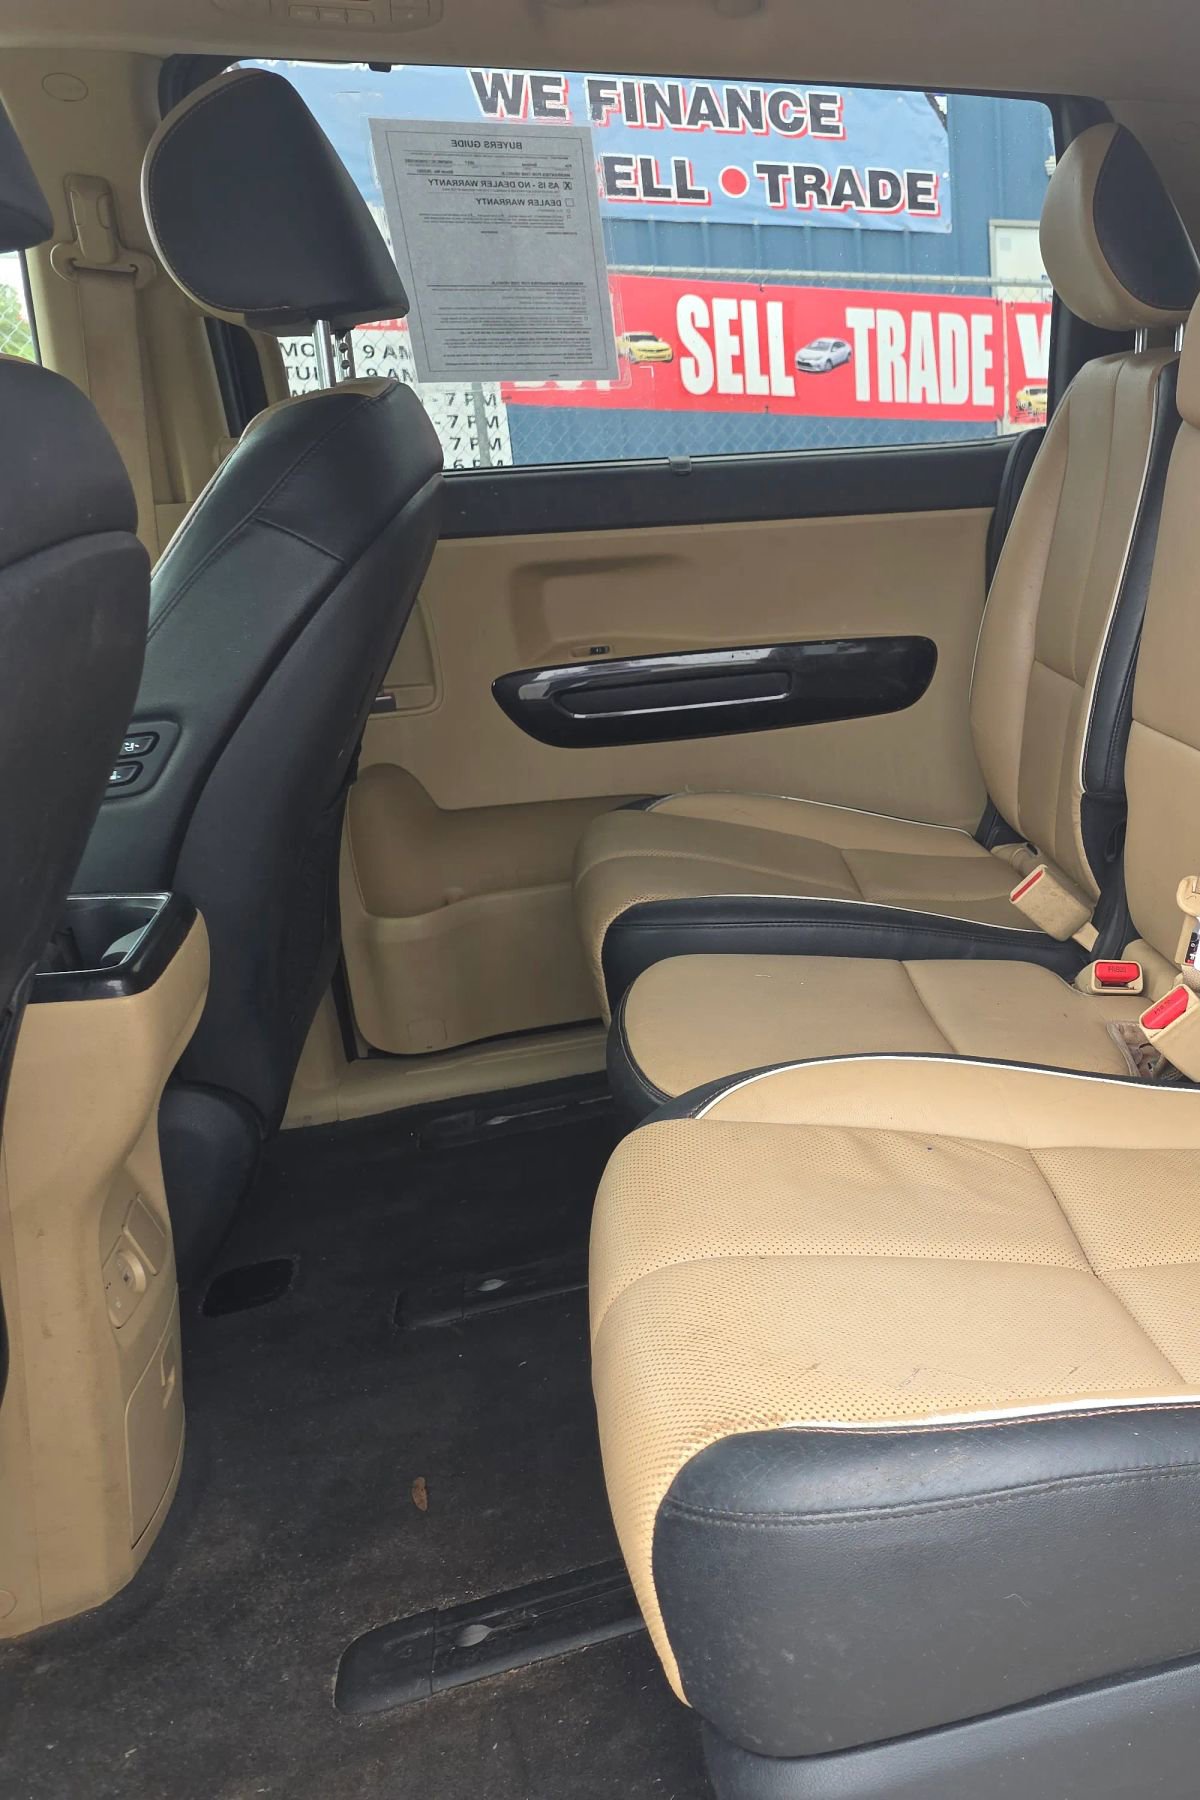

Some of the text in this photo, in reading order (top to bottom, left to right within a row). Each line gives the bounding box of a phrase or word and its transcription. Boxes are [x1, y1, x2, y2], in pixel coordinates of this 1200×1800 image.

[469, 69, 844, 137] WE FINANCE
[602, 155, 938, 213] ELL TRADE
[362, 344, 375, 359] 9
[676, 294, 796, 397] SELL
[845, 307, 995, 406] TRADE
[445, 392, 456, 406] 7
[447, 415, 459, 429] 7
[449, 437, 461, 451] 7
